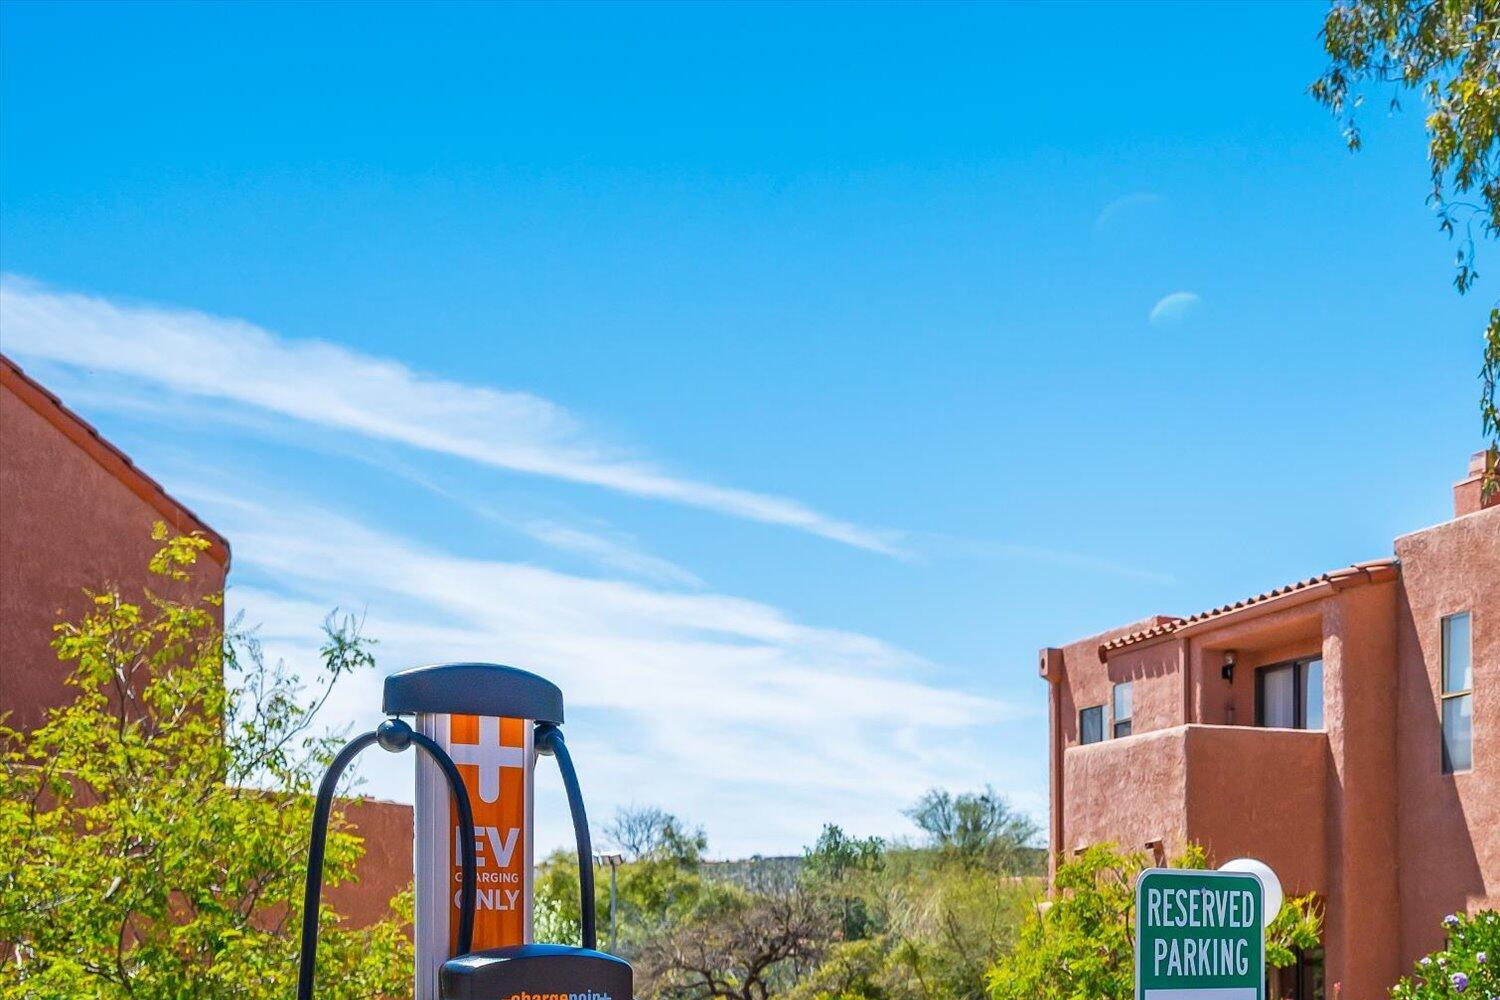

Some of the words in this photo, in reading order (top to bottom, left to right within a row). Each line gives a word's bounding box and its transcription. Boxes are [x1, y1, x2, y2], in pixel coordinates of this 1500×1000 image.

[455, 826, 520, 868] EV
[455, 872, 519, 883] CARGING
[1148, 888, 1254, 928] RESERVED
[1154, 938, 1249, 976] PARKING
